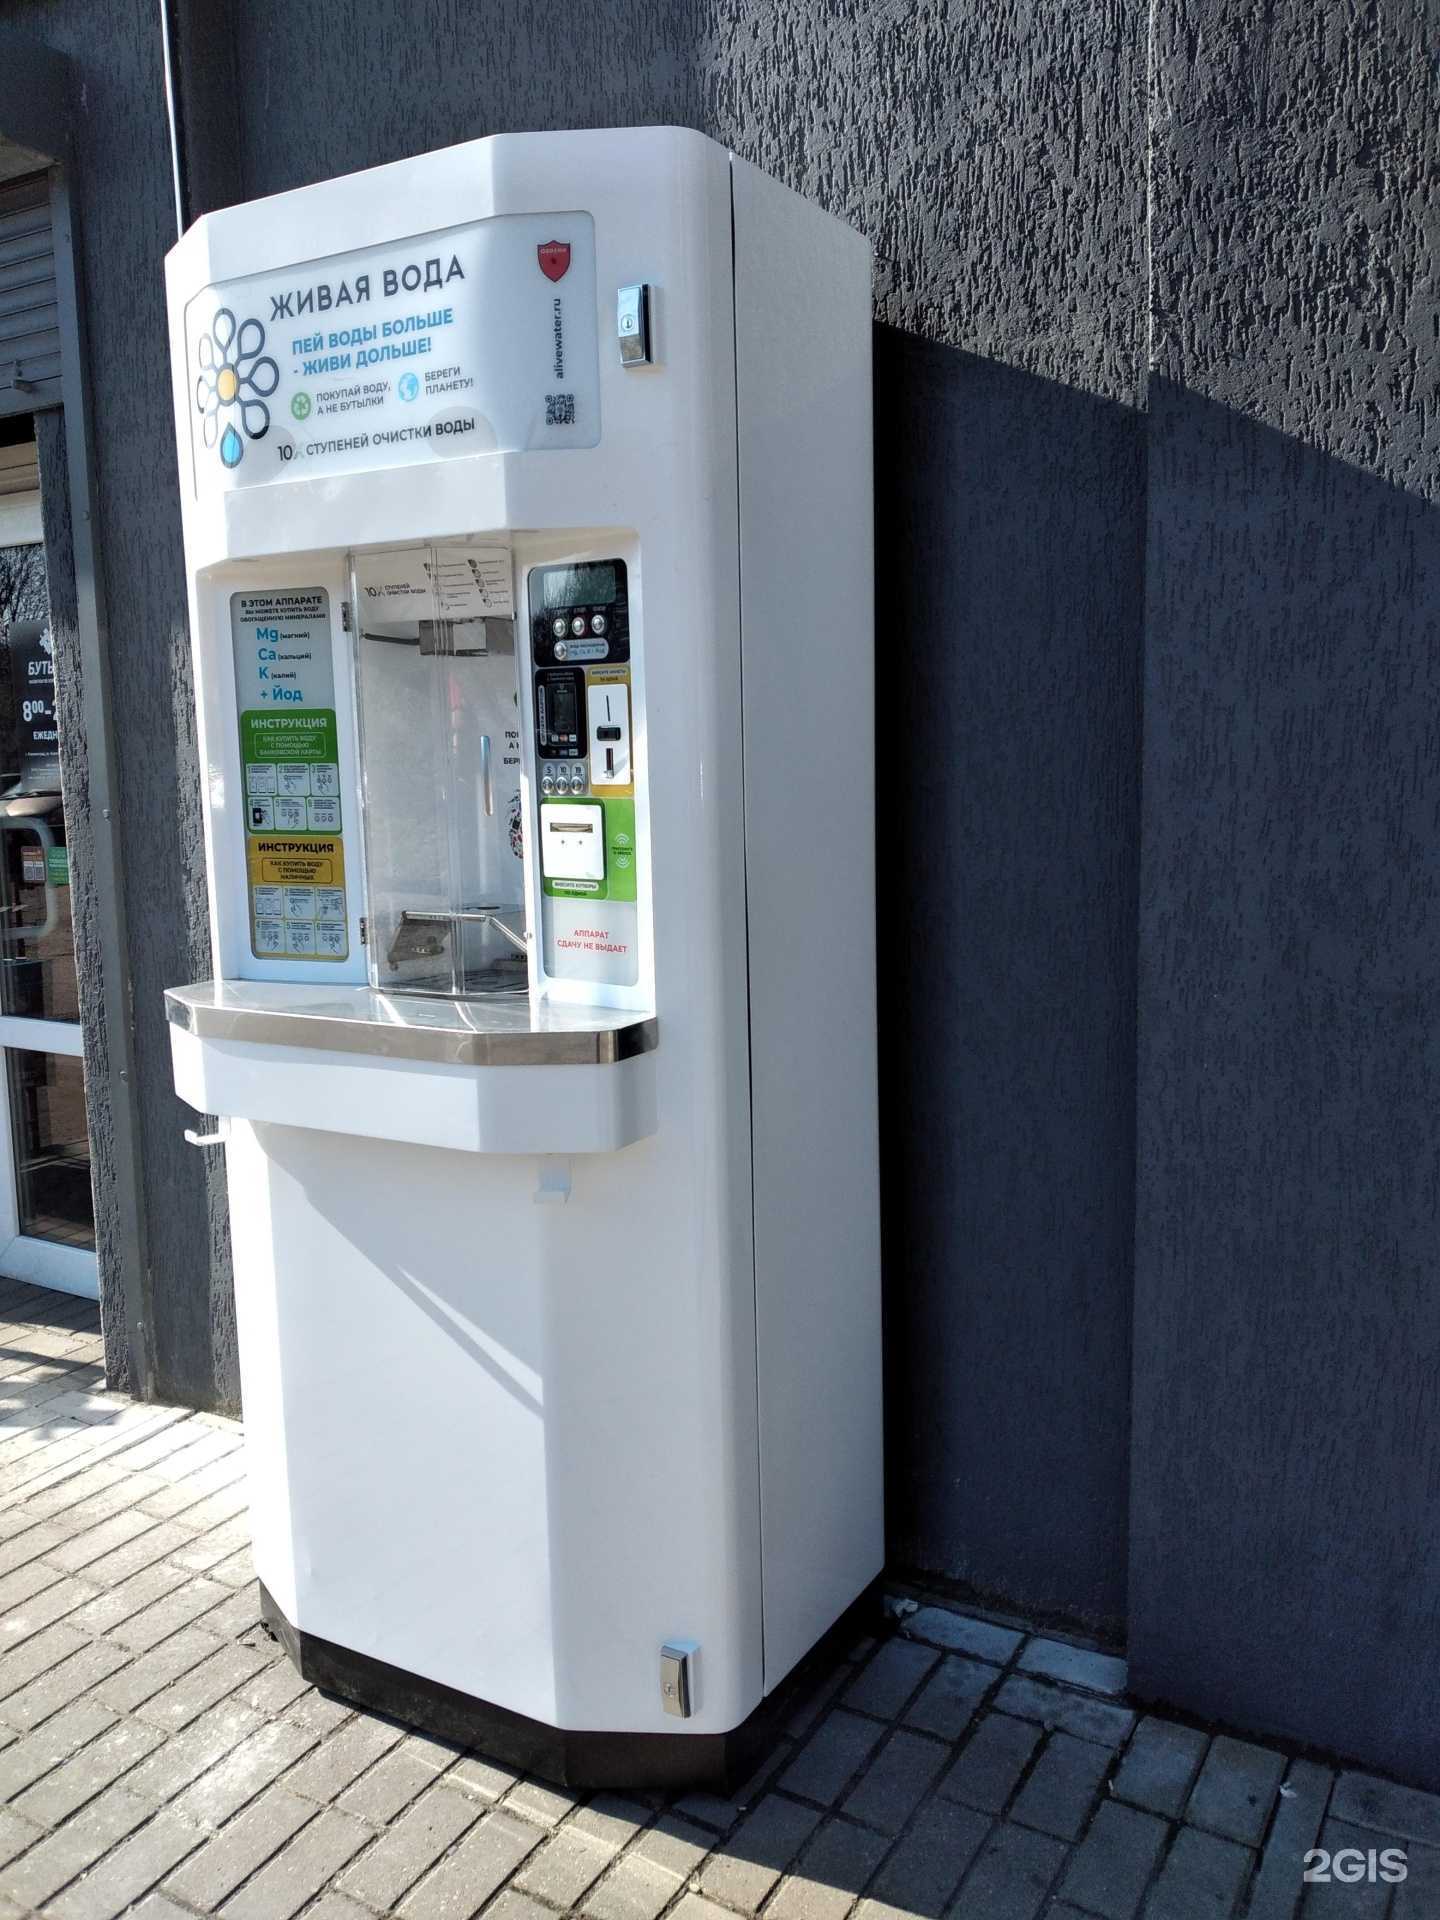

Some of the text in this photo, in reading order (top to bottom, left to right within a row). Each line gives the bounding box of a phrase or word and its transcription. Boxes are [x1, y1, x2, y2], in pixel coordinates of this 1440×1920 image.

[270, 254, 465, 321] ЖИВАЯ ВОДА
[292, 308, 453, 355] ПЕЙ ВОДЫ БОЛЬШЕ
[553, 298, 564, 379] alivewater.ru
[302, 353, 351, 376] ЖИВИ
[356, 337, 432, 369] ДОЛЬШЕ!
[425, 366, 461, 381] БЕРЕГИ
[317, 381, 391, 402] ПОКУПАЙ ВОДУ,
[425, 378, 474, 395] ПЛАНЕТУ!
[317, 396, 384, 415] А НЕ БУТЫЛКИ
[277, 417, 475, 461] 10 СТУПЕНЕЙ ОЧИСТКИ ВОДЫ
[241, 596, 323, 608] В ЭТОМ АППАРАТЕ
[256, 627, 279, 642] Mg
[280, 631, 310, 641] (магний)
[271, 671, 297, 680] (калий)
[272, 685, 303, 702] Йод
[250, 717, 327, 729] ИНСТРУКЦИЯ
[504, 757, 520, 765] БЕР
[258, 842, 334, 854] ИНСТРУКЦИЯ
[574, 929, 609, 939] АППАРАТ
[557, 939, 628, 953] СДАЧУ НЕ ВЫДАЕТ
